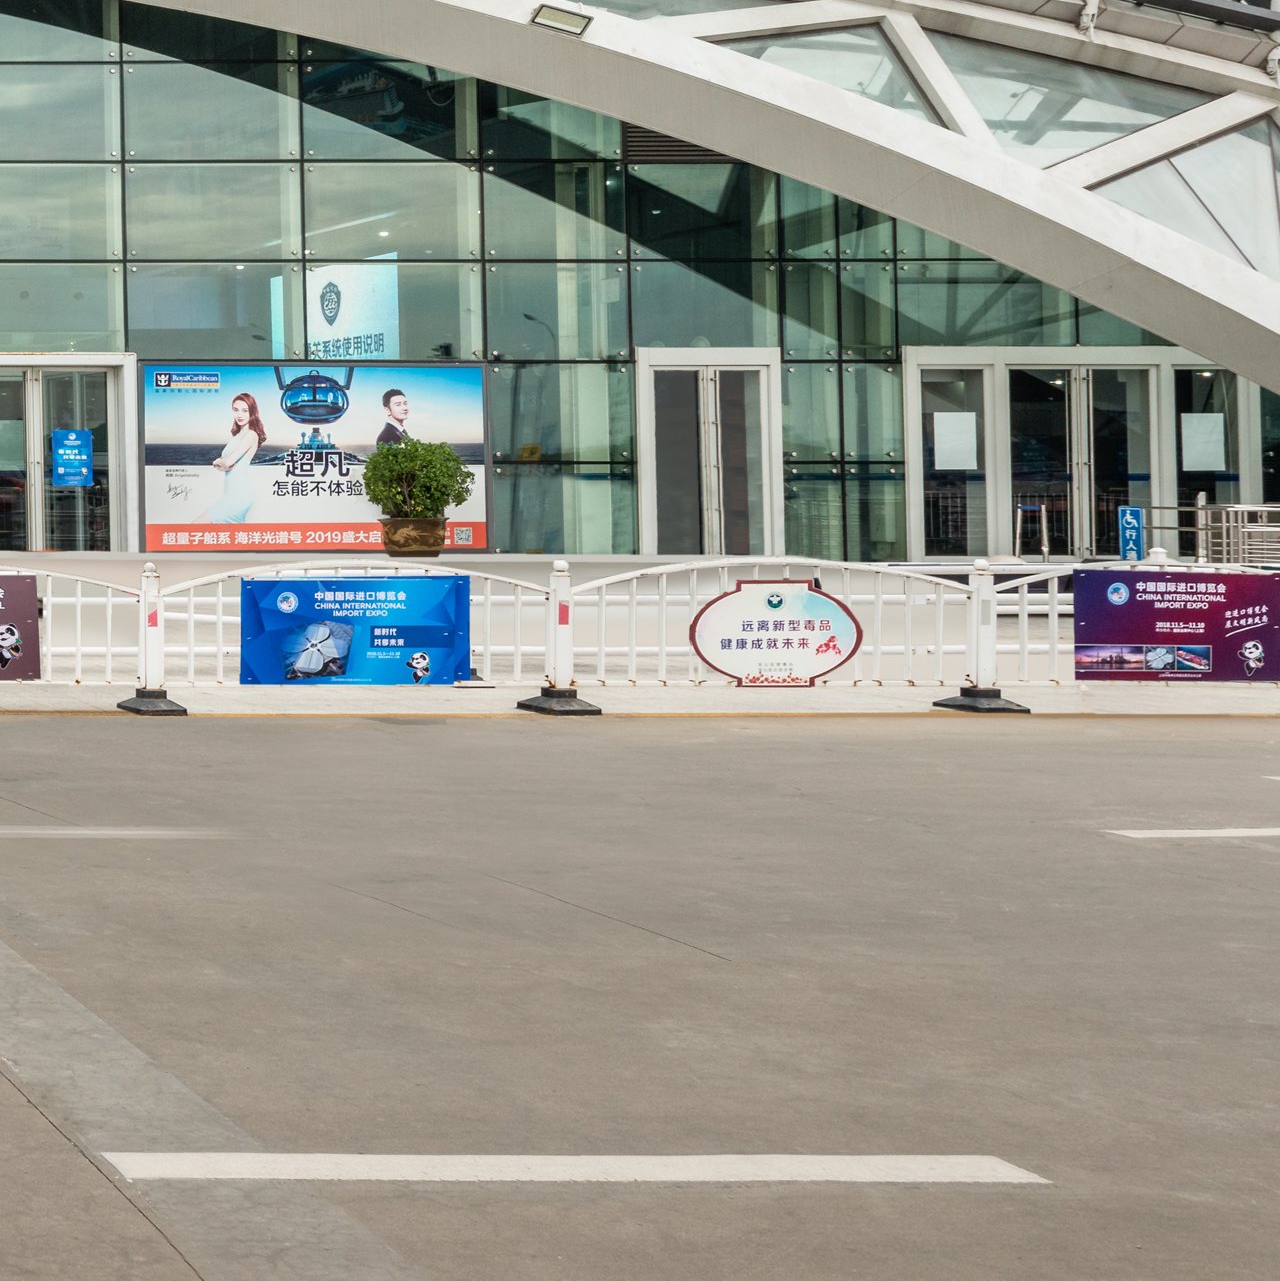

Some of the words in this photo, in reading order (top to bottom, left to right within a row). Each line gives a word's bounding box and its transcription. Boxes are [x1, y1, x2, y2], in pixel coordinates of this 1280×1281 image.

[285, 449, 350, 477] 超凡
[272, 480, 363, 496] 怎能不体验
[162, 532, 231, 544] 超量子船系
[235, 531, 303, 544] 海洋光谱号
[306, 530, 382, 543] 2019盛大启
[1136, 582, 1226, 594] 中国国际进口博览会
[314, 591, 407, 601] 中国国际进口博览会
[1163, 594, 1227, 602] INTERNATIONAL
[741, 619, 832, 632] 远离新型毒品
[720, 637, 811, 650] 健康成就未来
